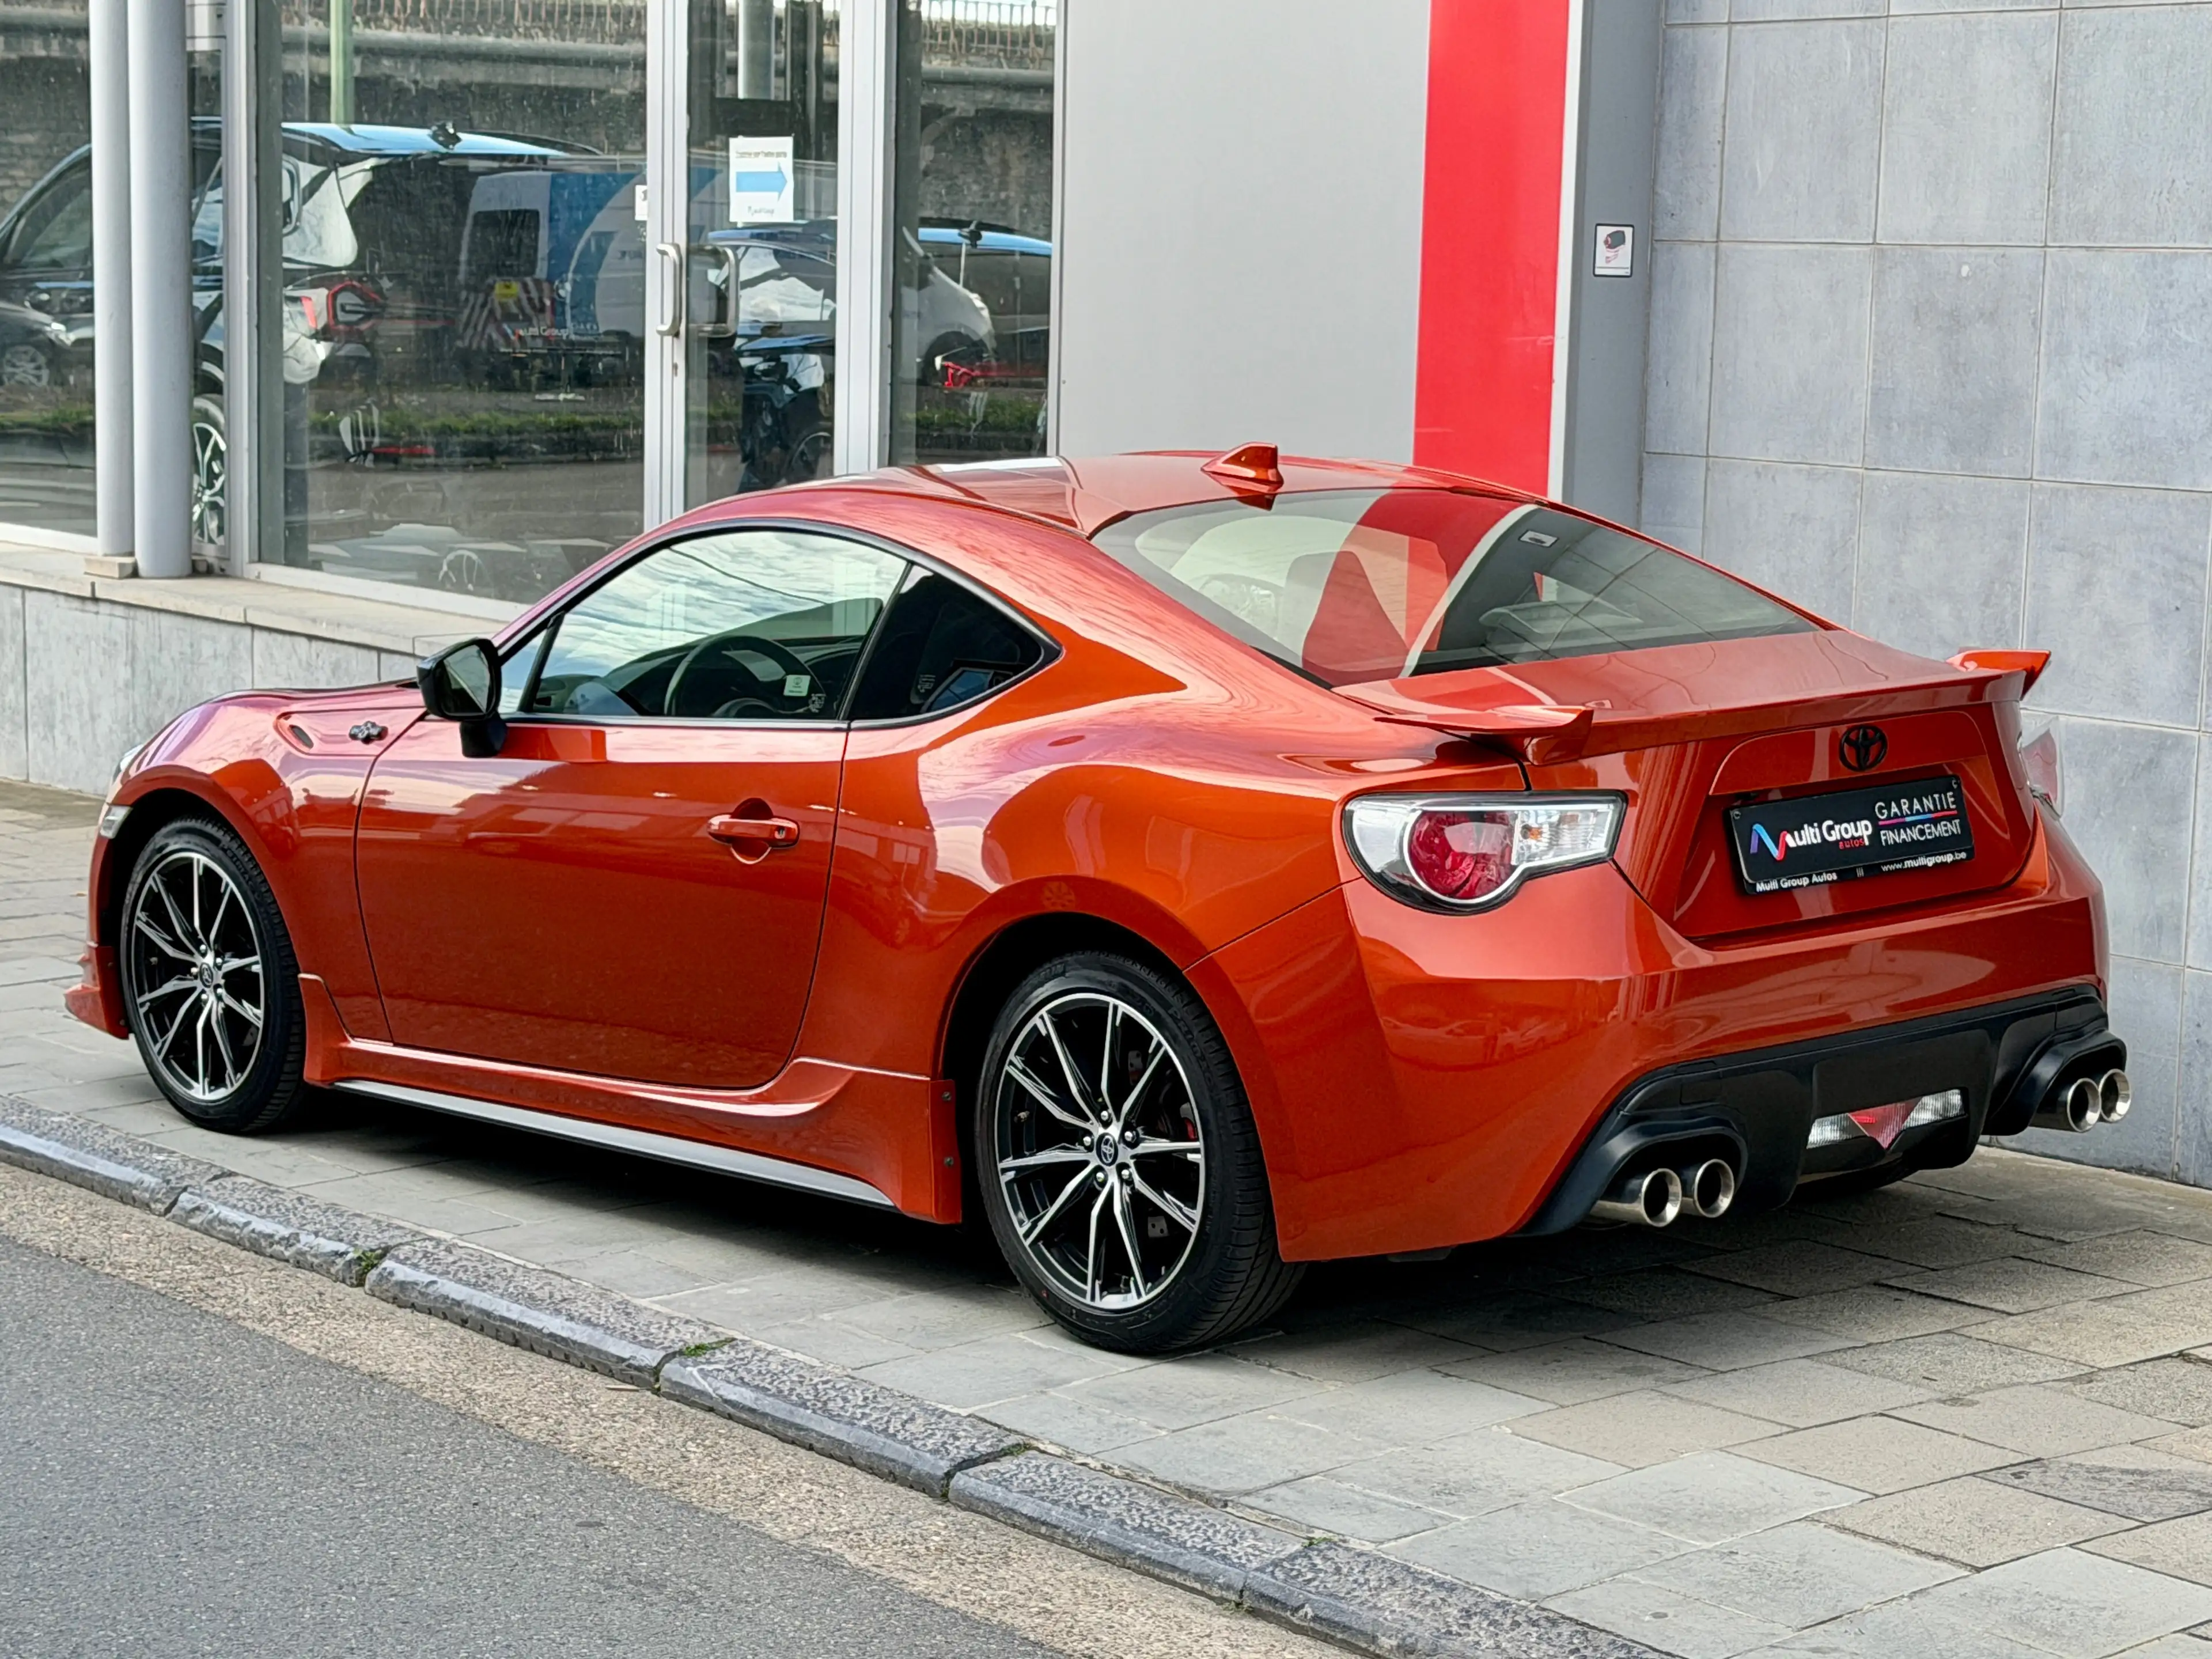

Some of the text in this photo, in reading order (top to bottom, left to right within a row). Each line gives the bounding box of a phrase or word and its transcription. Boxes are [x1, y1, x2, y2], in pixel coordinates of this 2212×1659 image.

[1874, 791, 1957, 820] GARANTIE
[1750, 819, 1872, 861] Multi Group
[1838, 838, 1865, 850] autos
[1880, 819, 1961, 846] FINANCEMENT
[1881, 851, 1967, 872] www.multigroup.be
[1756, 872, 1838, 893] Multi Group Autos
